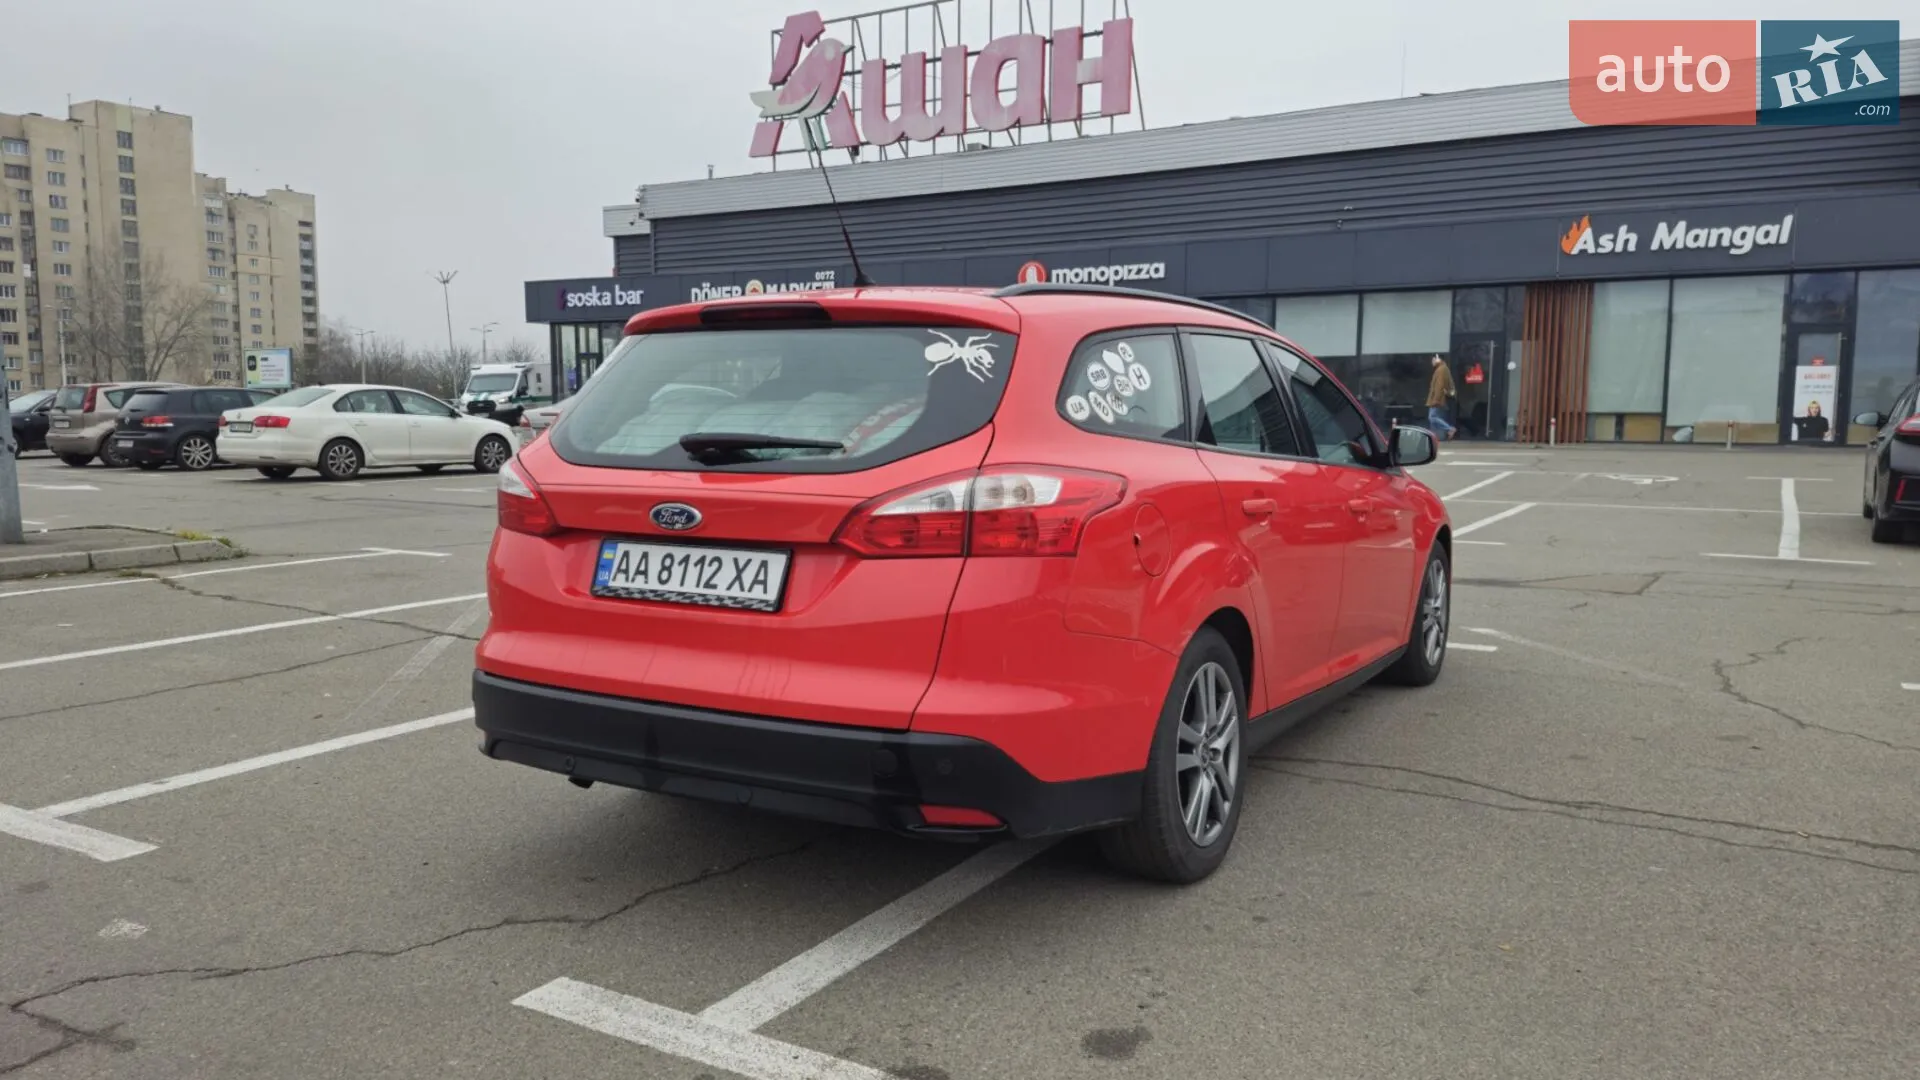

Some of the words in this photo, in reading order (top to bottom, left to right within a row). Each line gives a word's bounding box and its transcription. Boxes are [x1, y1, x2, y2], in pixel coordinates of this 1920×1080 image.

[1570, 224, 1638, 255] Ash
[1650, 214, 1794, 255] Mangal
[1051, 262, 1166, 287] monopizza
[566, 286, 611, 307] soska
[615, 285, 645, 306] bar
[1132, 367, 1147, 386] H
[1070, 401, 1086, 414] UA
[659, 507, 689, 525] Ford
[611, 550, 650, 585] AA
[657, 552, 723, 590] 8112
[726, 557, 769, 594] XA
